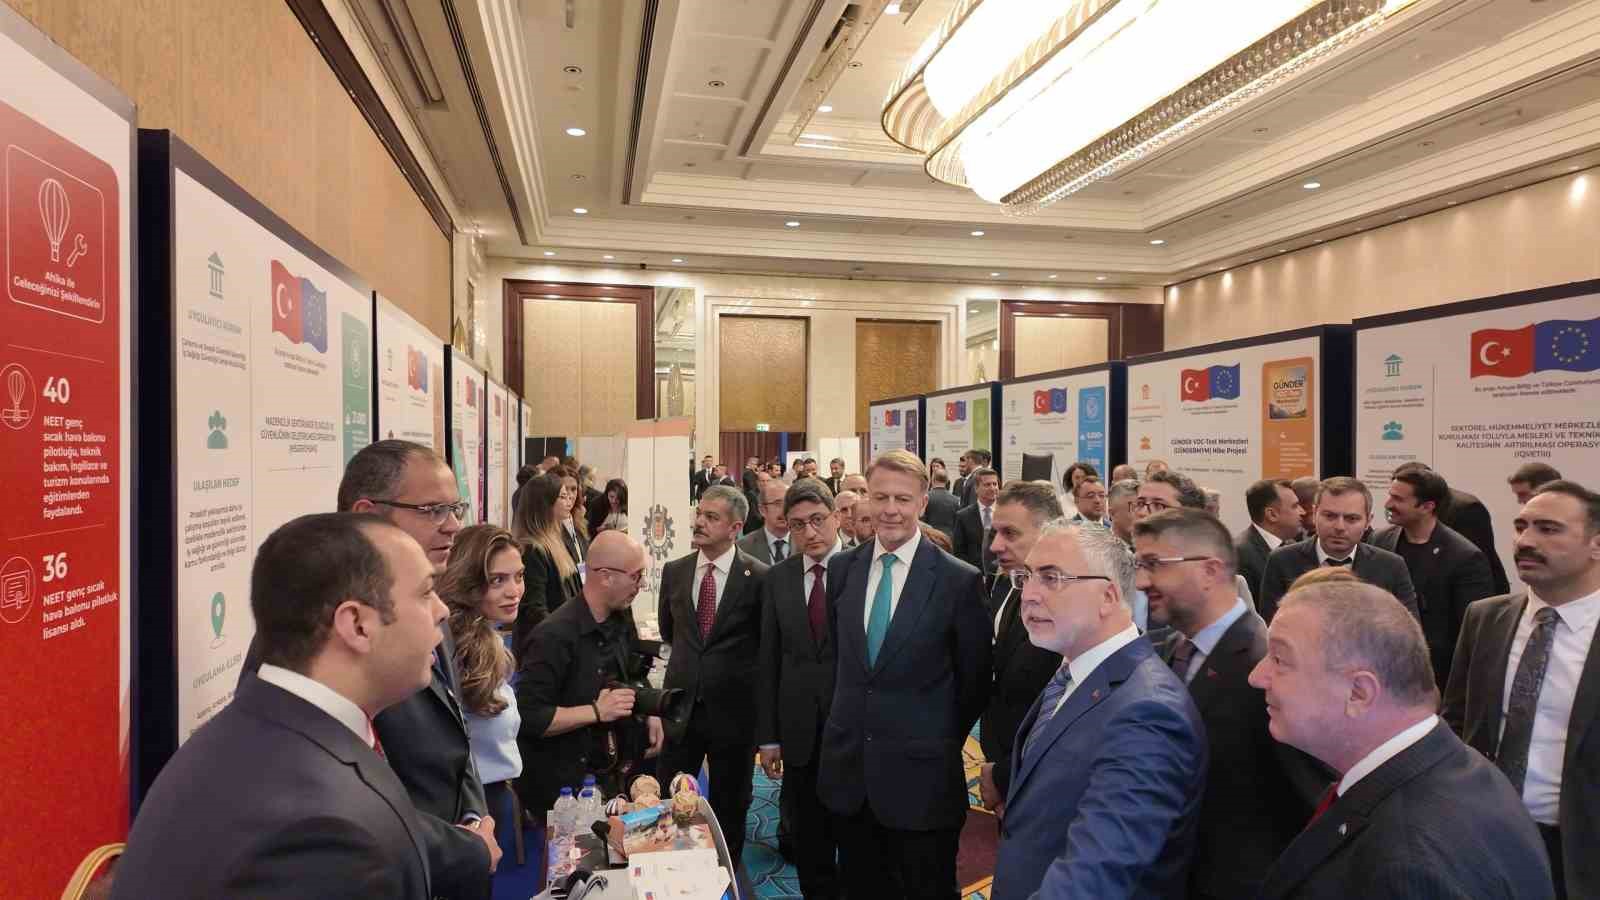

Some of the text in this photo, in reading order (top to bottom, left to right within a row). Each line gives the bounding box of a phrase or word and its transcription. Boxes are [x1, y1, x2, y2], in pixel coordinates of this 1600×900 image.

[43, 377, 70, 404] 40
[43, 416, 64, 427] NEET
[65, 432, 82, 442] hava
[43, 552, 68, 582] 36
[43, 590, 66, 607] NEET
[43, 609, 63, 623] hava
